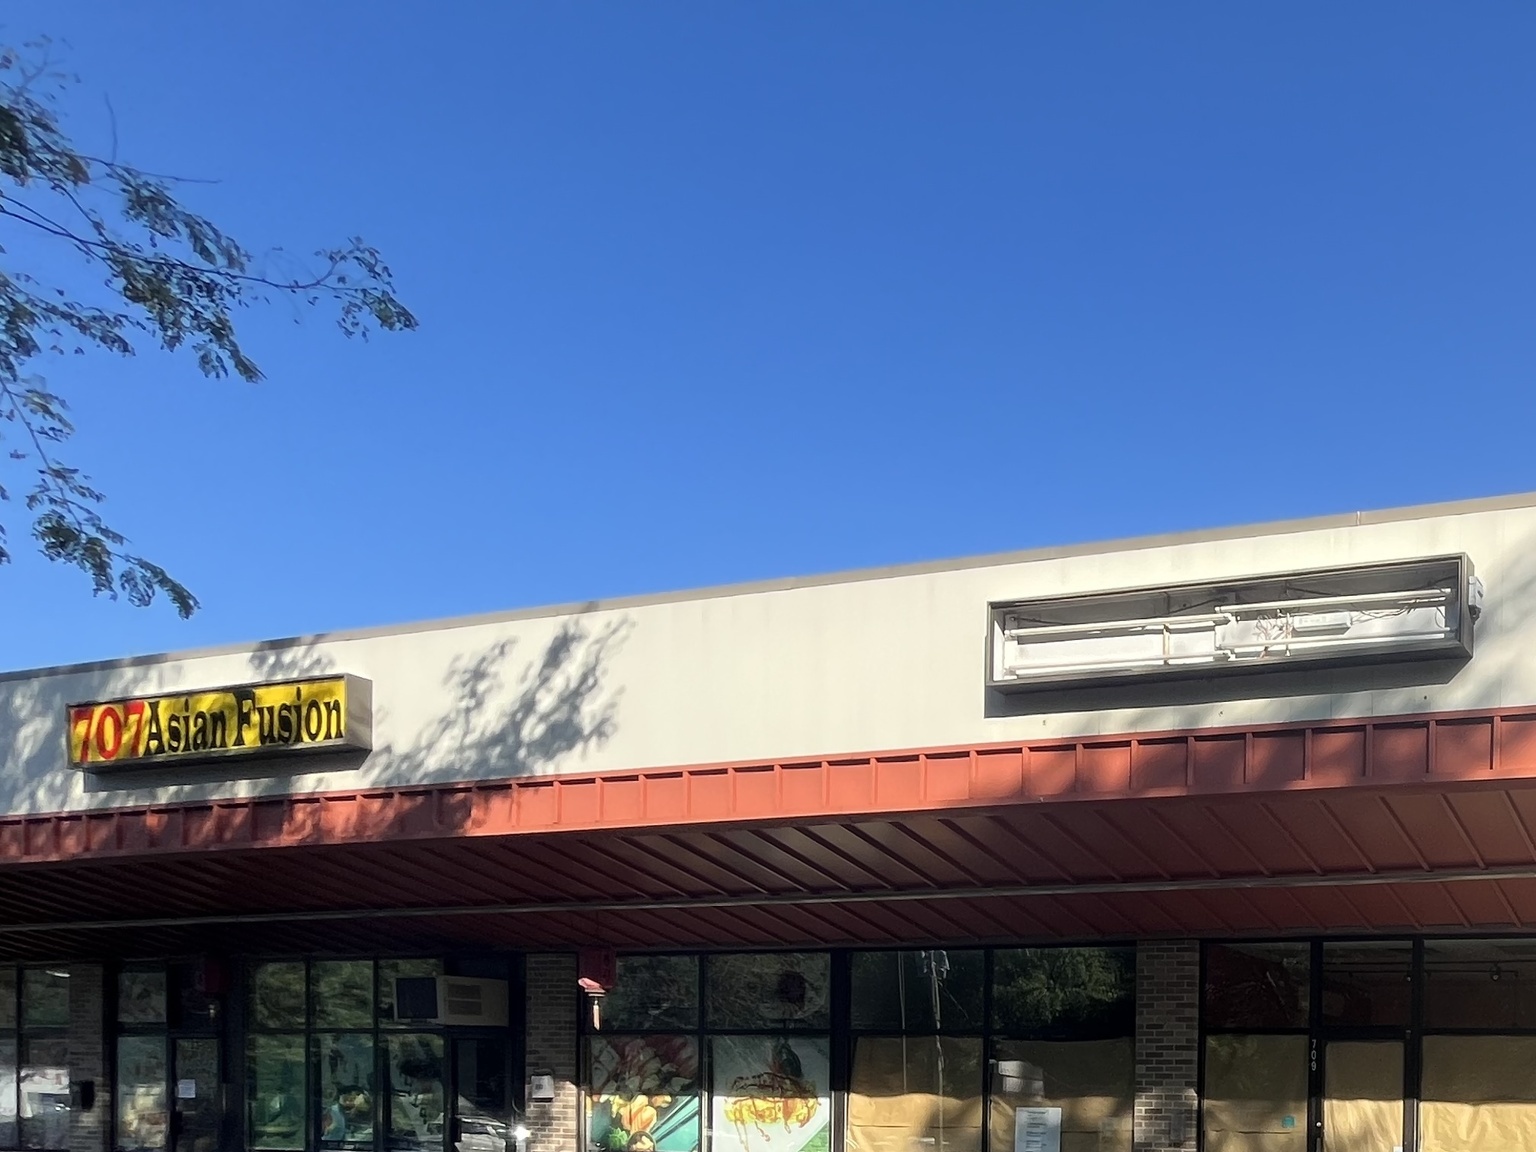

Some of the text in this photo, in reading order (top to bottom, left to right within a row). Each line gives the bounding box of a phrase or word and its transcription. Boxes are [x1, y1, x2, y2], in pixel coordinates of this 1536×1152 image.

[73, 686, 344, 763] 707 Asian Fusion
